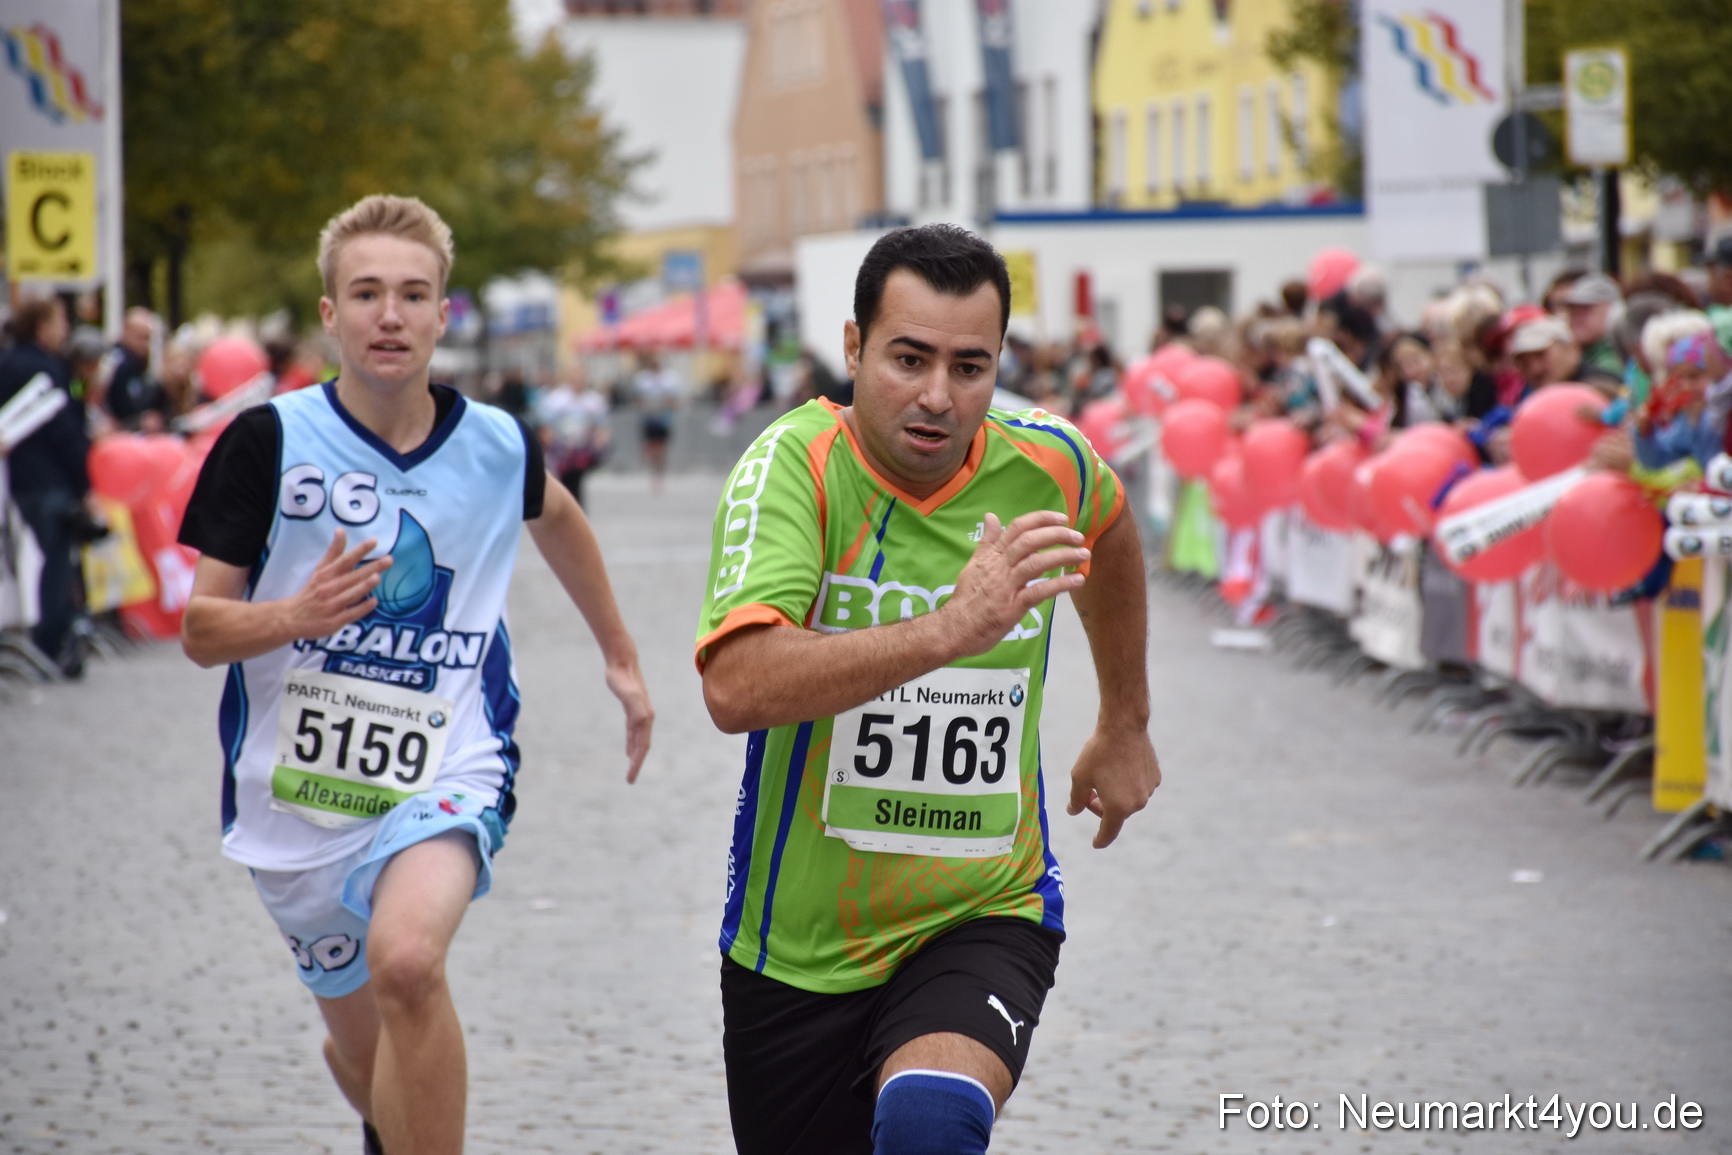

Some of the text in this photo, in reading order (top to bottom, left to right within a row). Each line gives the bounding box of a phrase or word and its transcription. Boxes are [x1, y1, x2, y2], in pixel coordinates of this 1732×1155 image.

[30, 190, 71, 252] C
[281, 463, 380, 527] 66
[338, 659, 424, 686] BASKETS
[287, 683, 421, 722] PARTL Neumarkt
[916, 687, 1004, 705] Neumarkt
[294, 708, 429, 785] 5159
[853, 712, 1010, 785] 5163
[836, 770, 845, 783] S
[874, 798, 982, 831] Sleiman
